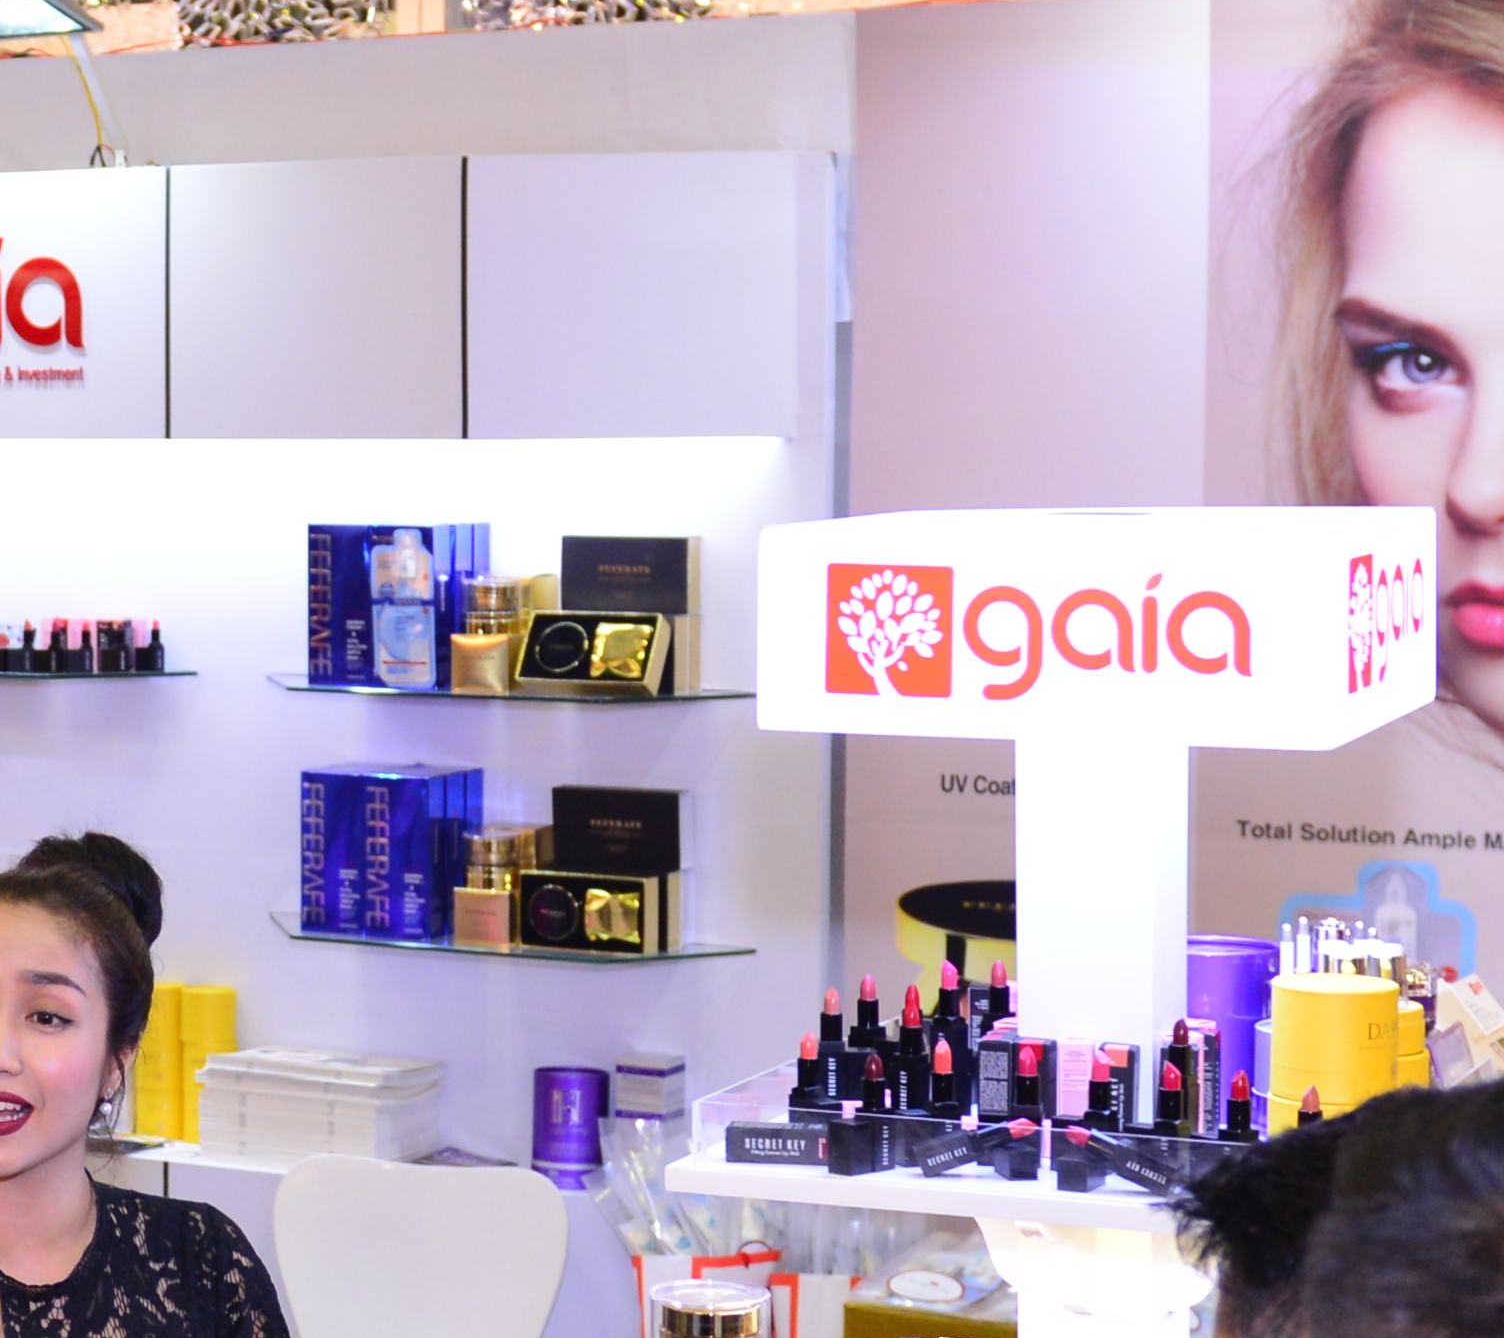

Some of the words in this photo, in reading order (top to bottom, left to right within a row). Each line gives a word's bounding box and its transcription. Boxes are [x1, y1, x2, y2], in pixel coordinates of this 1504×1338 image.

[18, 365, 84, 381] Investment
[941, 774, 968, 794] UV
[1237, 818, 1292, 841] Total
[1300, 822, 1395, 846] Solution
[1403, 827, 1477, 852] Ample
[828, 1057, 836, 1070] KEY
[828, 1072, 836, 1097] SECRET
[744, 1137, 784, 1151] SECRET
[786, 1139, 806, 1151] KEY
[954, 1146, 969, 1159] KEY
